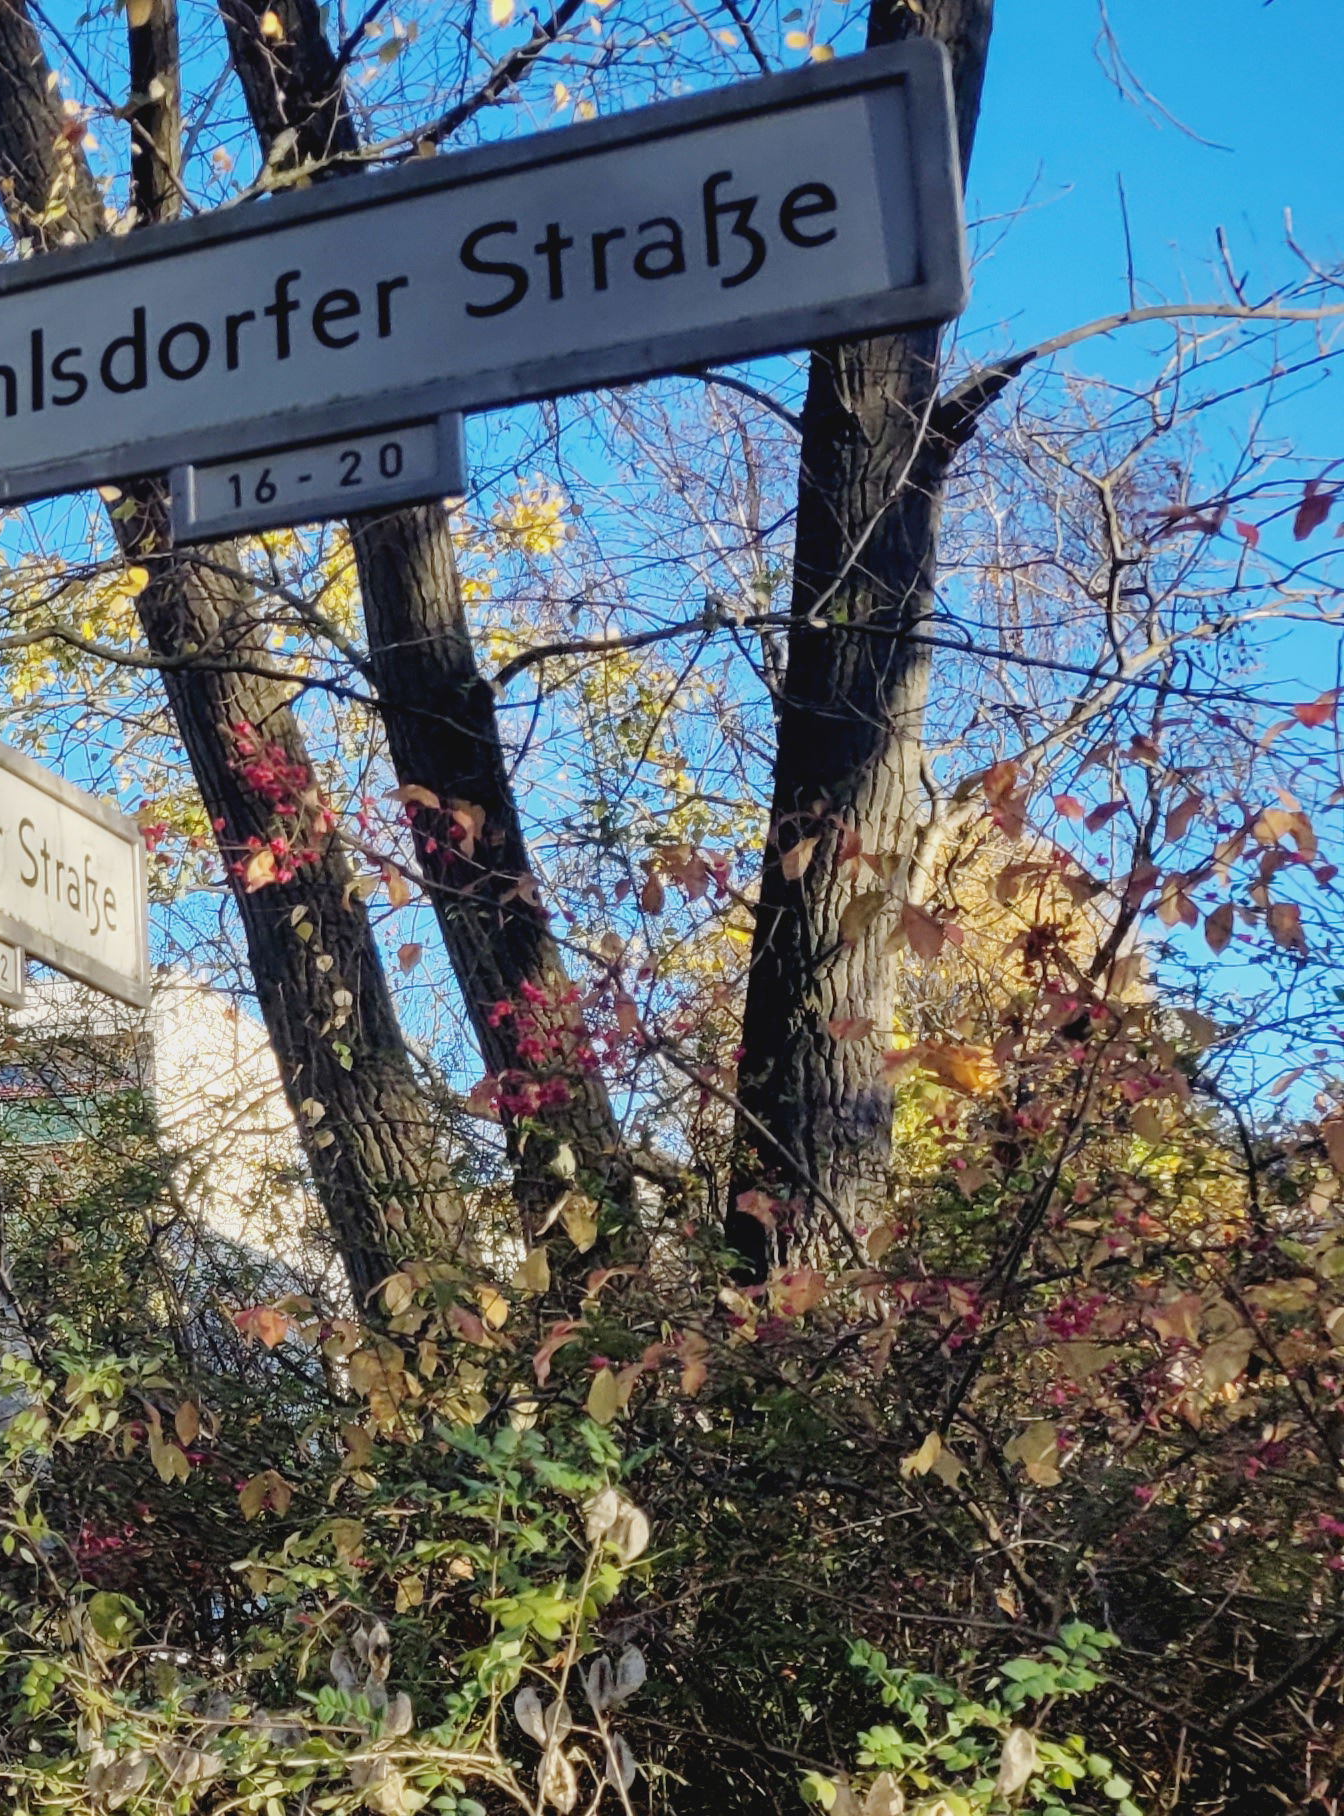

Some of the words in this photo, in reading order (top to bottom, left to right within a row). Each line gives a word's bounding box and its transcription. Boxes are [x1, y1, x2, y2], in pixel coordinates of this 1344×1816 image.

[458, 170, 839, 319] Straße
[228, 468, 277, 509] 16
[296, 473, 313, 484] -
[339, 442, 403, 488] 20
[17, 816, 118, 937] Straße
